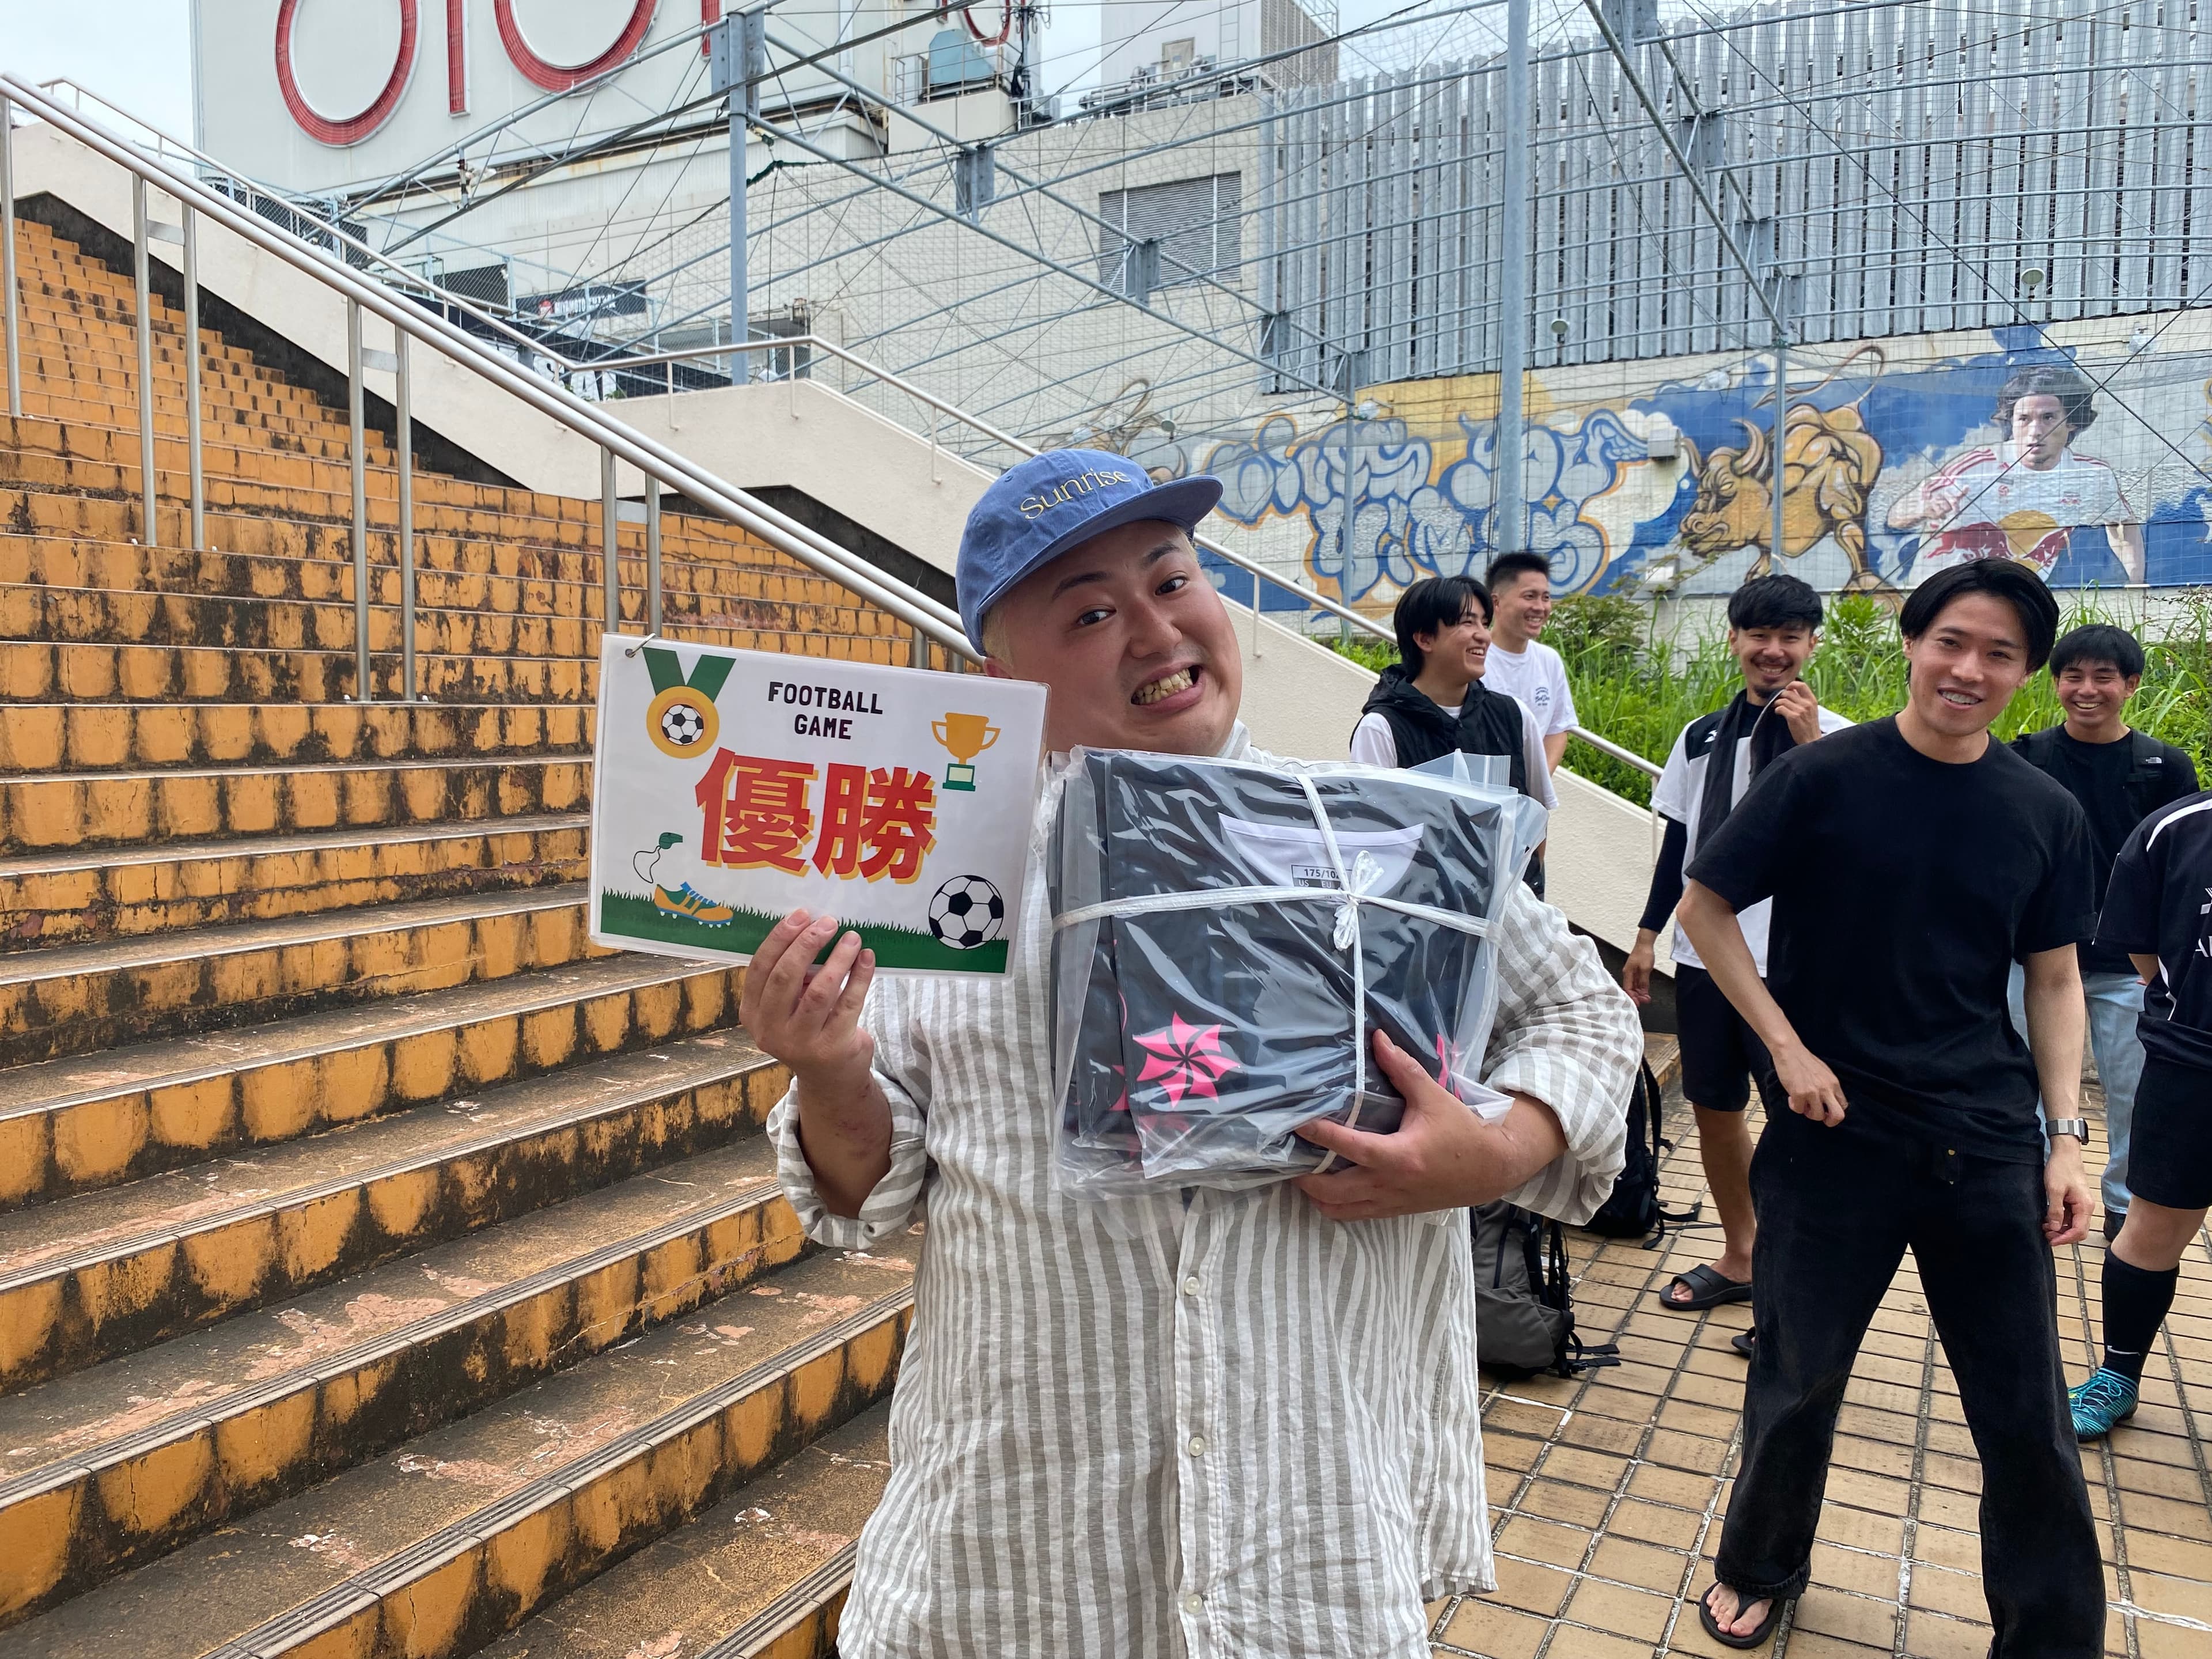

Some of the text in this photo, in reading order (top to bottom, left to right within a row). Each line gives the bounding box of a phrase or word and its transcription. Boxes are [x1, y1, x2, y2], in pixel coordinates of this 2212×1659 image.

[768, 681, 883, 714] FOOTBALL
[794, 714, 853, 740] GAME
[695, 747, 937, 884] 優勝
